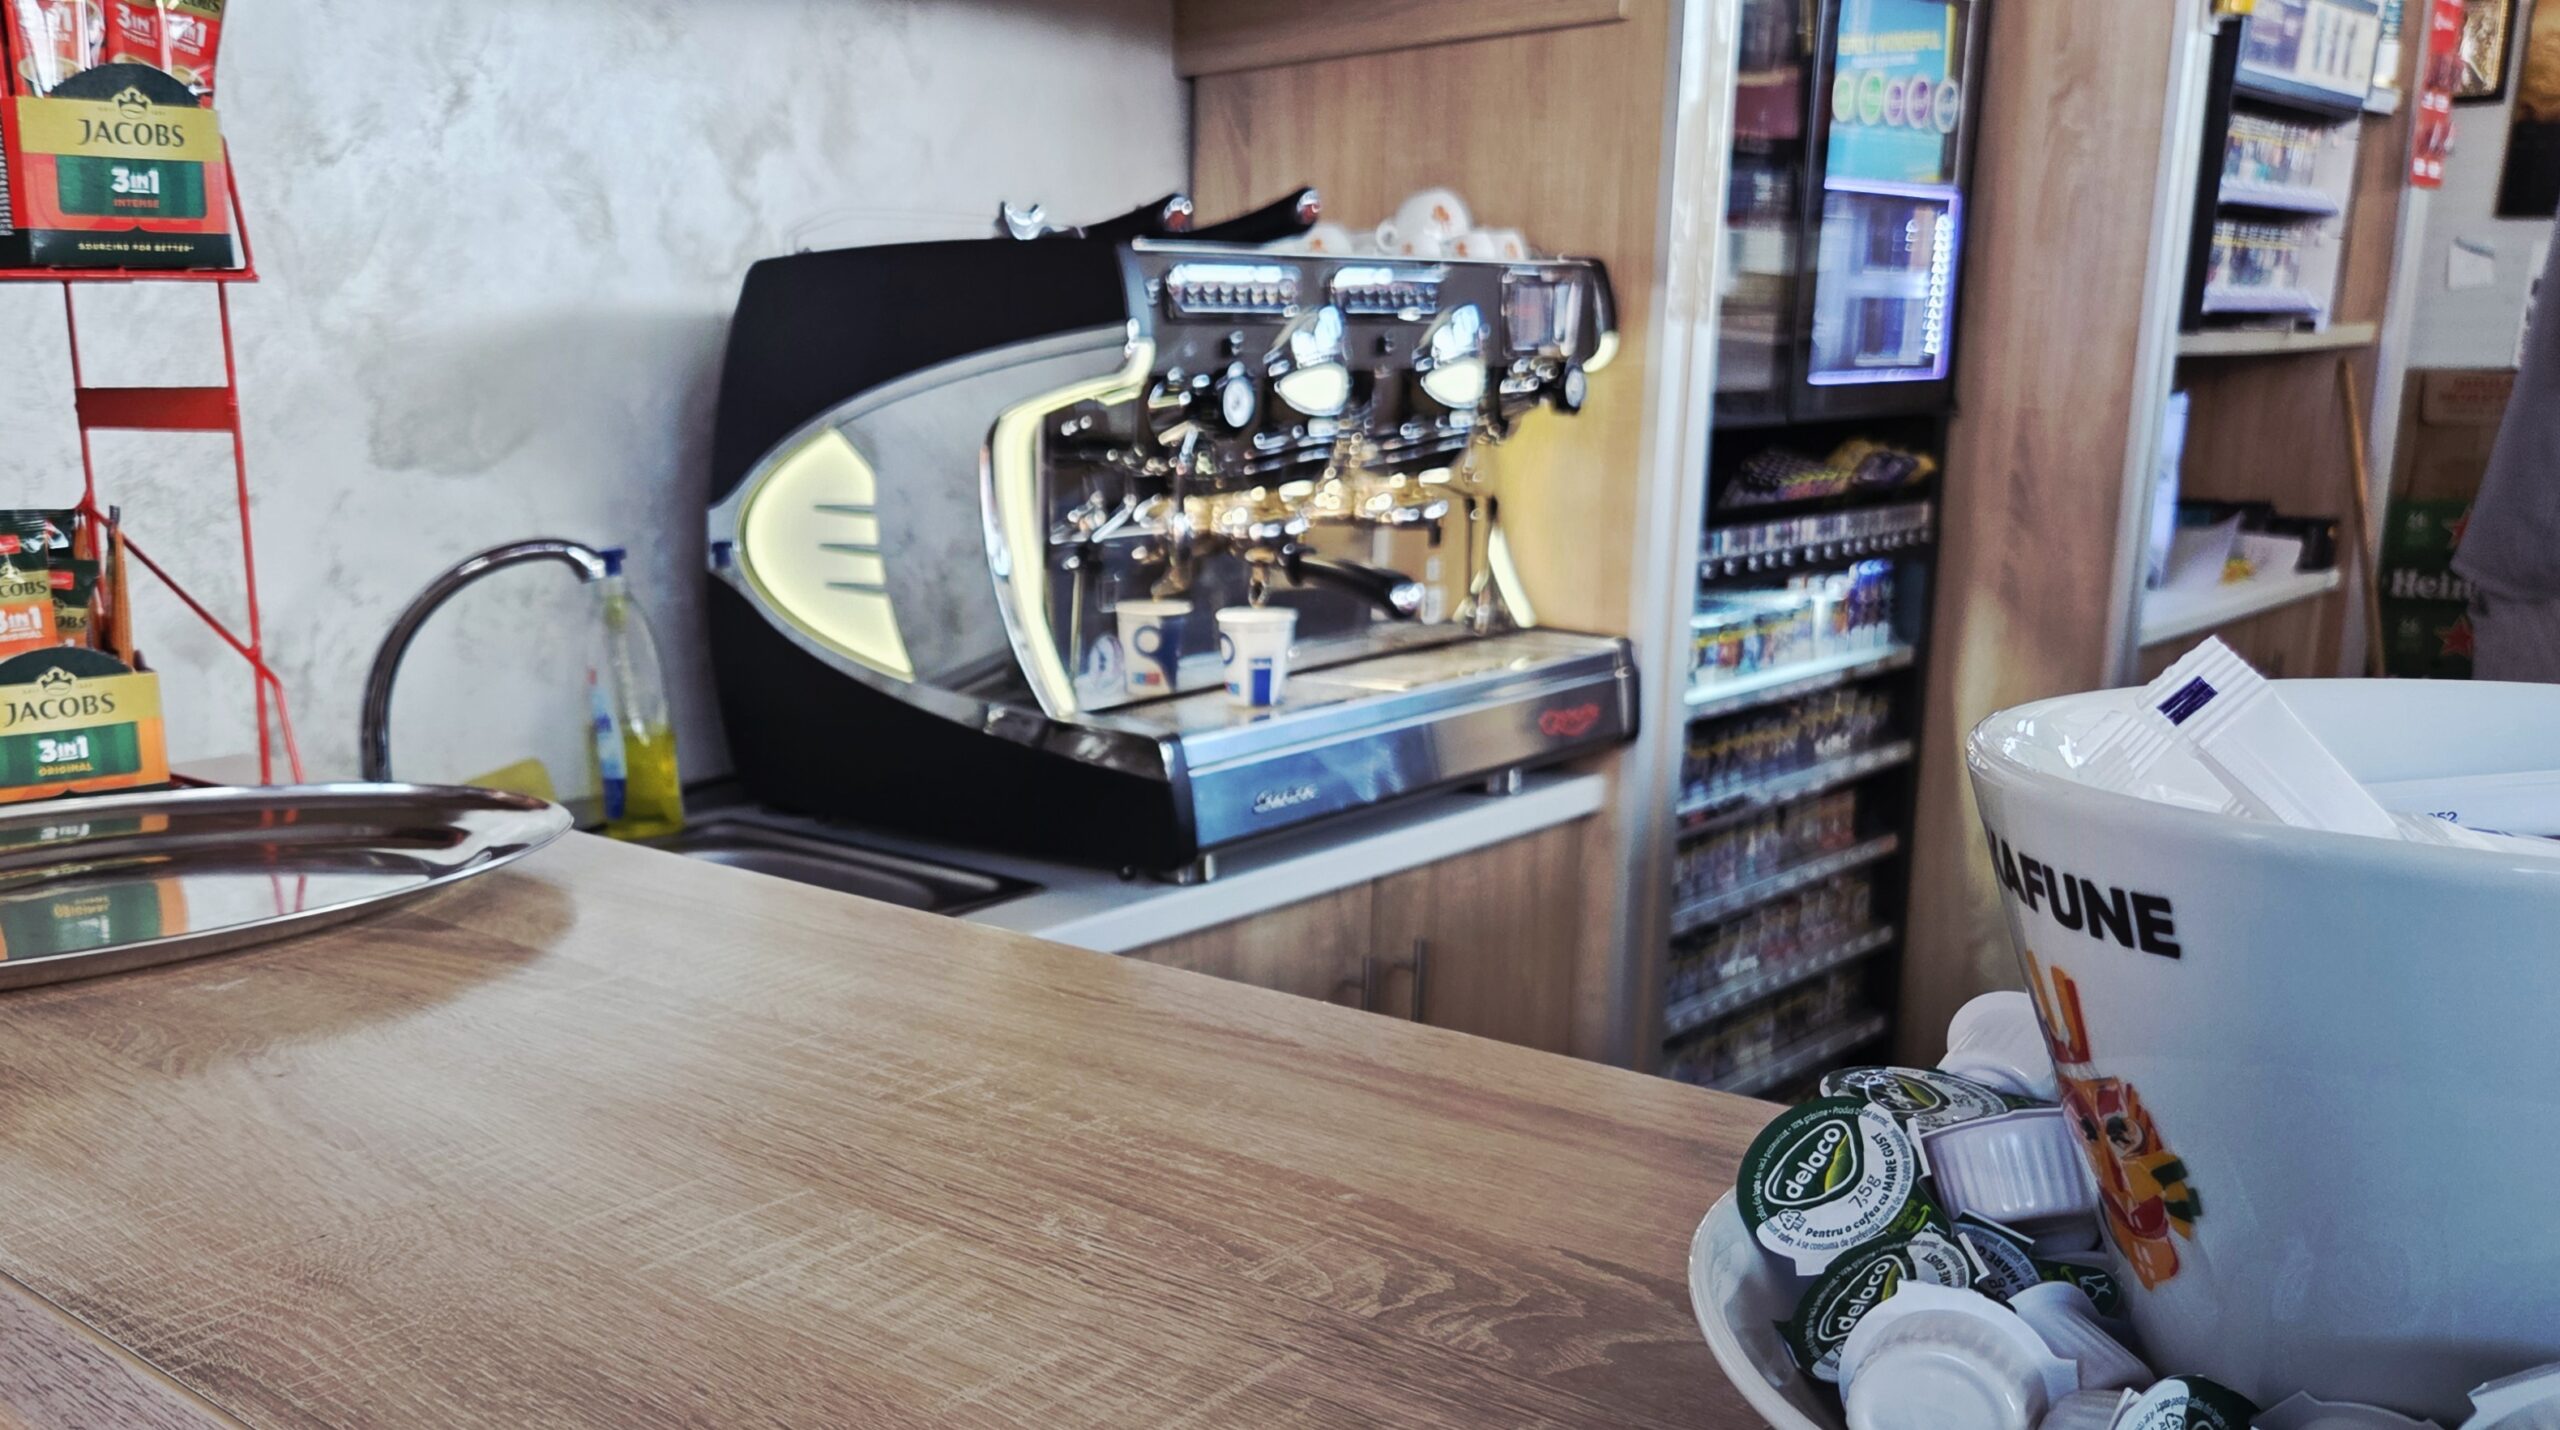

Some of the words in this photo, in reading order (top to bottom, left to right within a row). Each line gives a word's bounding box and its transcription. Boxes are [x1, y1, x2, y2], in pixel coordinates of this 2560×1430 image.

[78, 118, 185, 148] JACOBS
[112, 198, 160, 209] INTENSE
[78, 242, 129, 251] SOURCING
[132, 243, 151, 251] FOR
[154, 244, 190, 253] BETTER
[4, 692, 116, 728] JACOBS
[38, 762, 94, 777] ORIGINAL
[2427, 811, 2458, 824] 52
[1870, 1132, 1895, 1158] GUST
[1784, 1127, 1843, 1201] delaco
[1884, 1157, 1898, 1193] MARE
[1848, 1173, 1883, 1209] 7,5g
[1878, 1194, 1891, 1207] cu
[1844, 1225, 1853, 1233] o
[1852, 1206, 1881, 1230] cafea
[1805, 1225, 1844, 1239] Pentru
[1921, 1252, 1948, 1273] GUST
[1986, 1250, 2017, 1285] MARE
[1837, 1261, 1890, 1332] delaco
